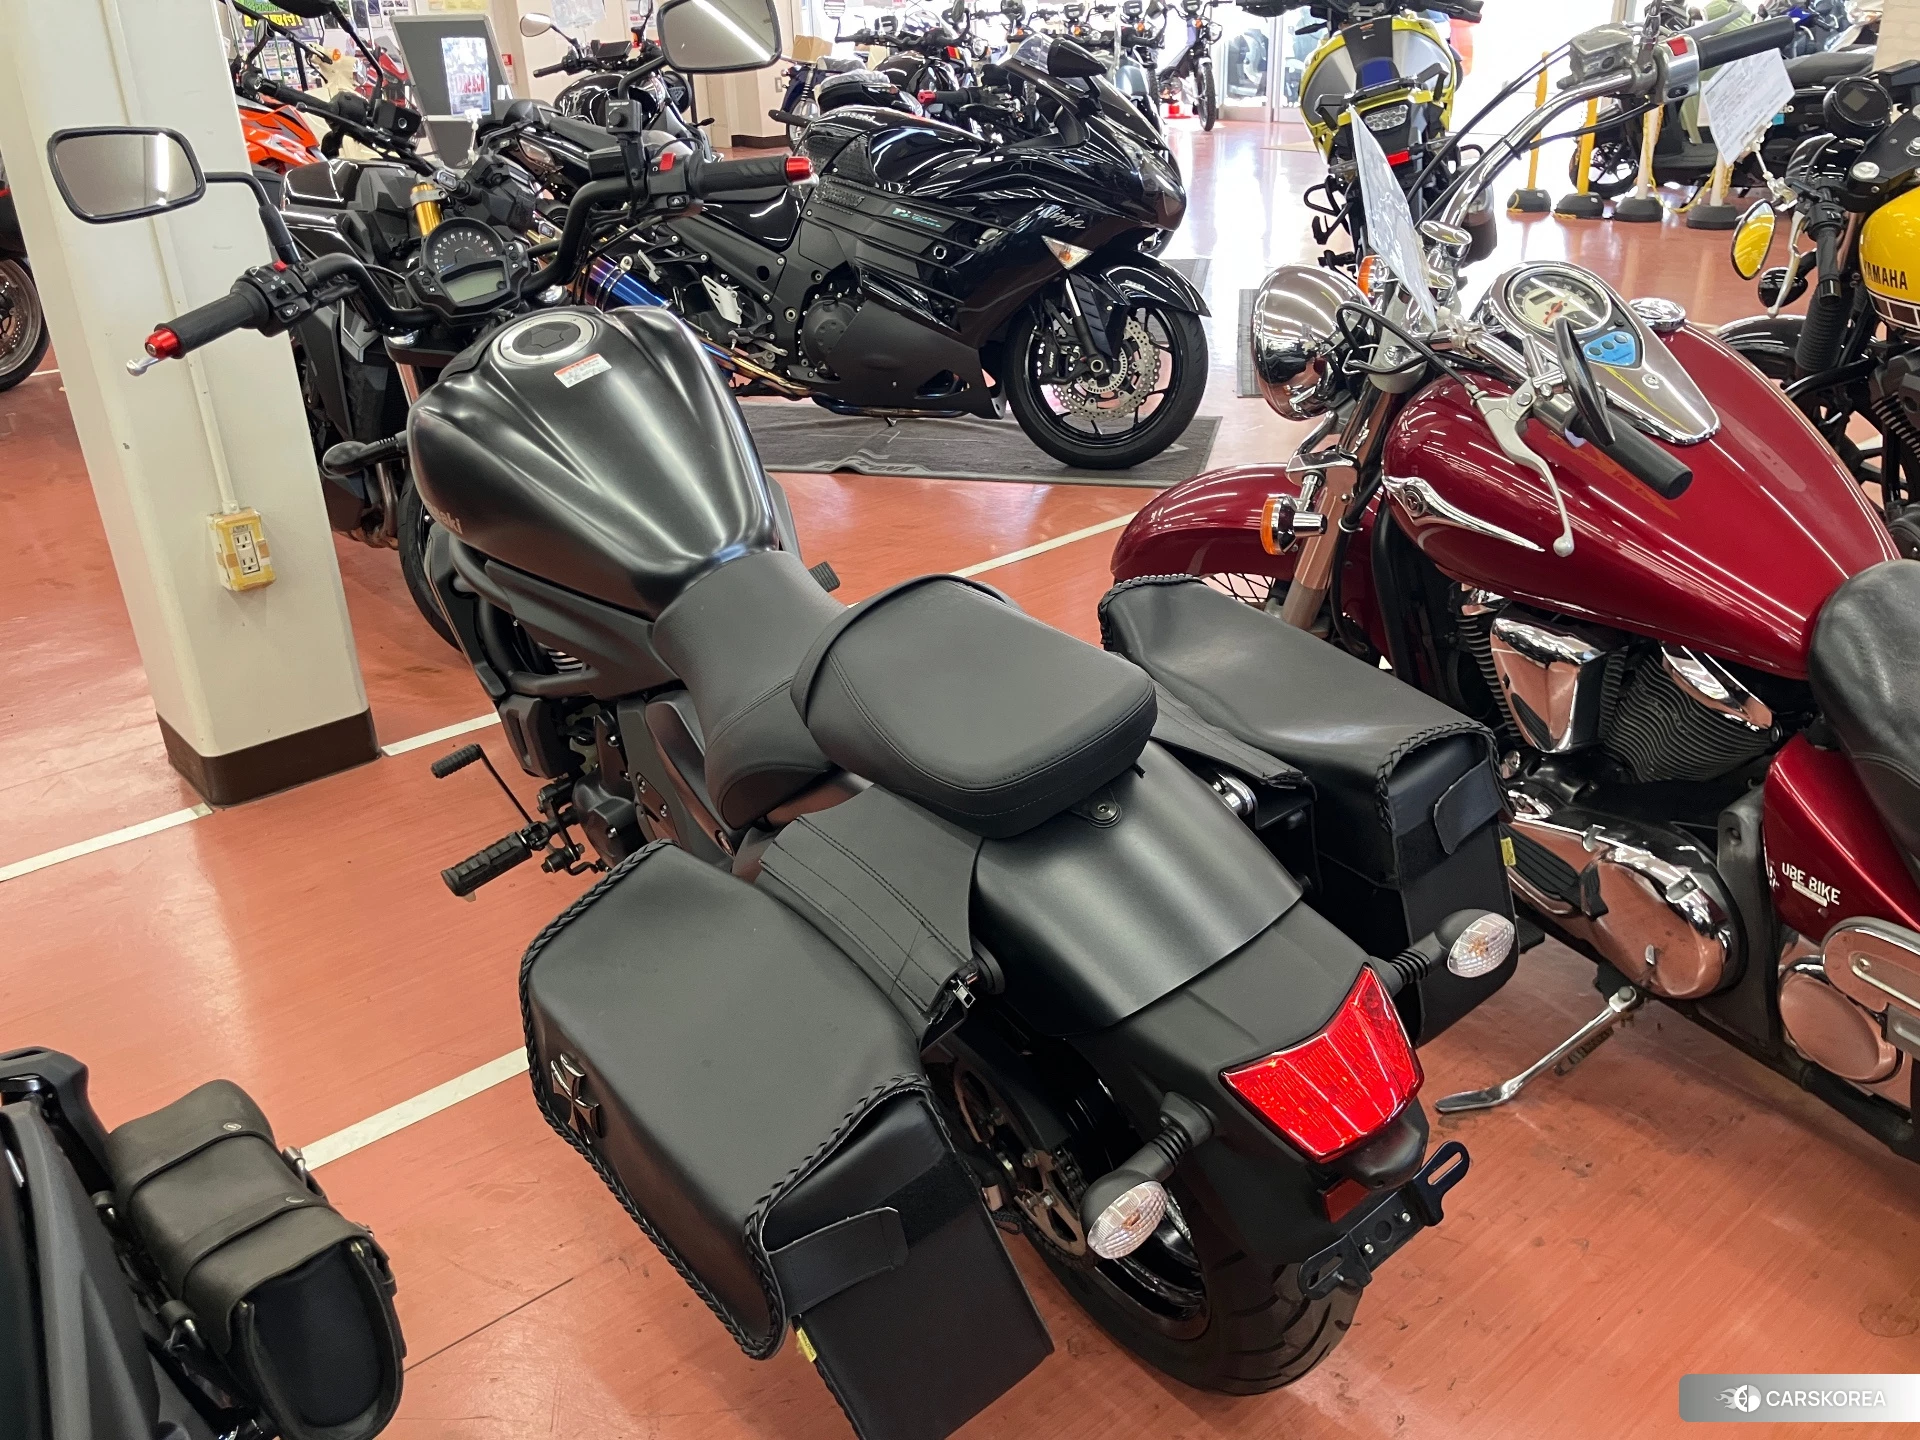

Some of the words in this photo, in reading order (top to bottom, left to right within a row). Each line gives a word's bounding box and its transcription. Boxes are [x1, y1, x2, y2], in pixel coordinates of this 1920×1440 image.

[1037, 204, 1086, 229] Ninja
[1863, 260, 1908, 291] YAMAHA
[1808, 876, 1841, 906] BIKE
